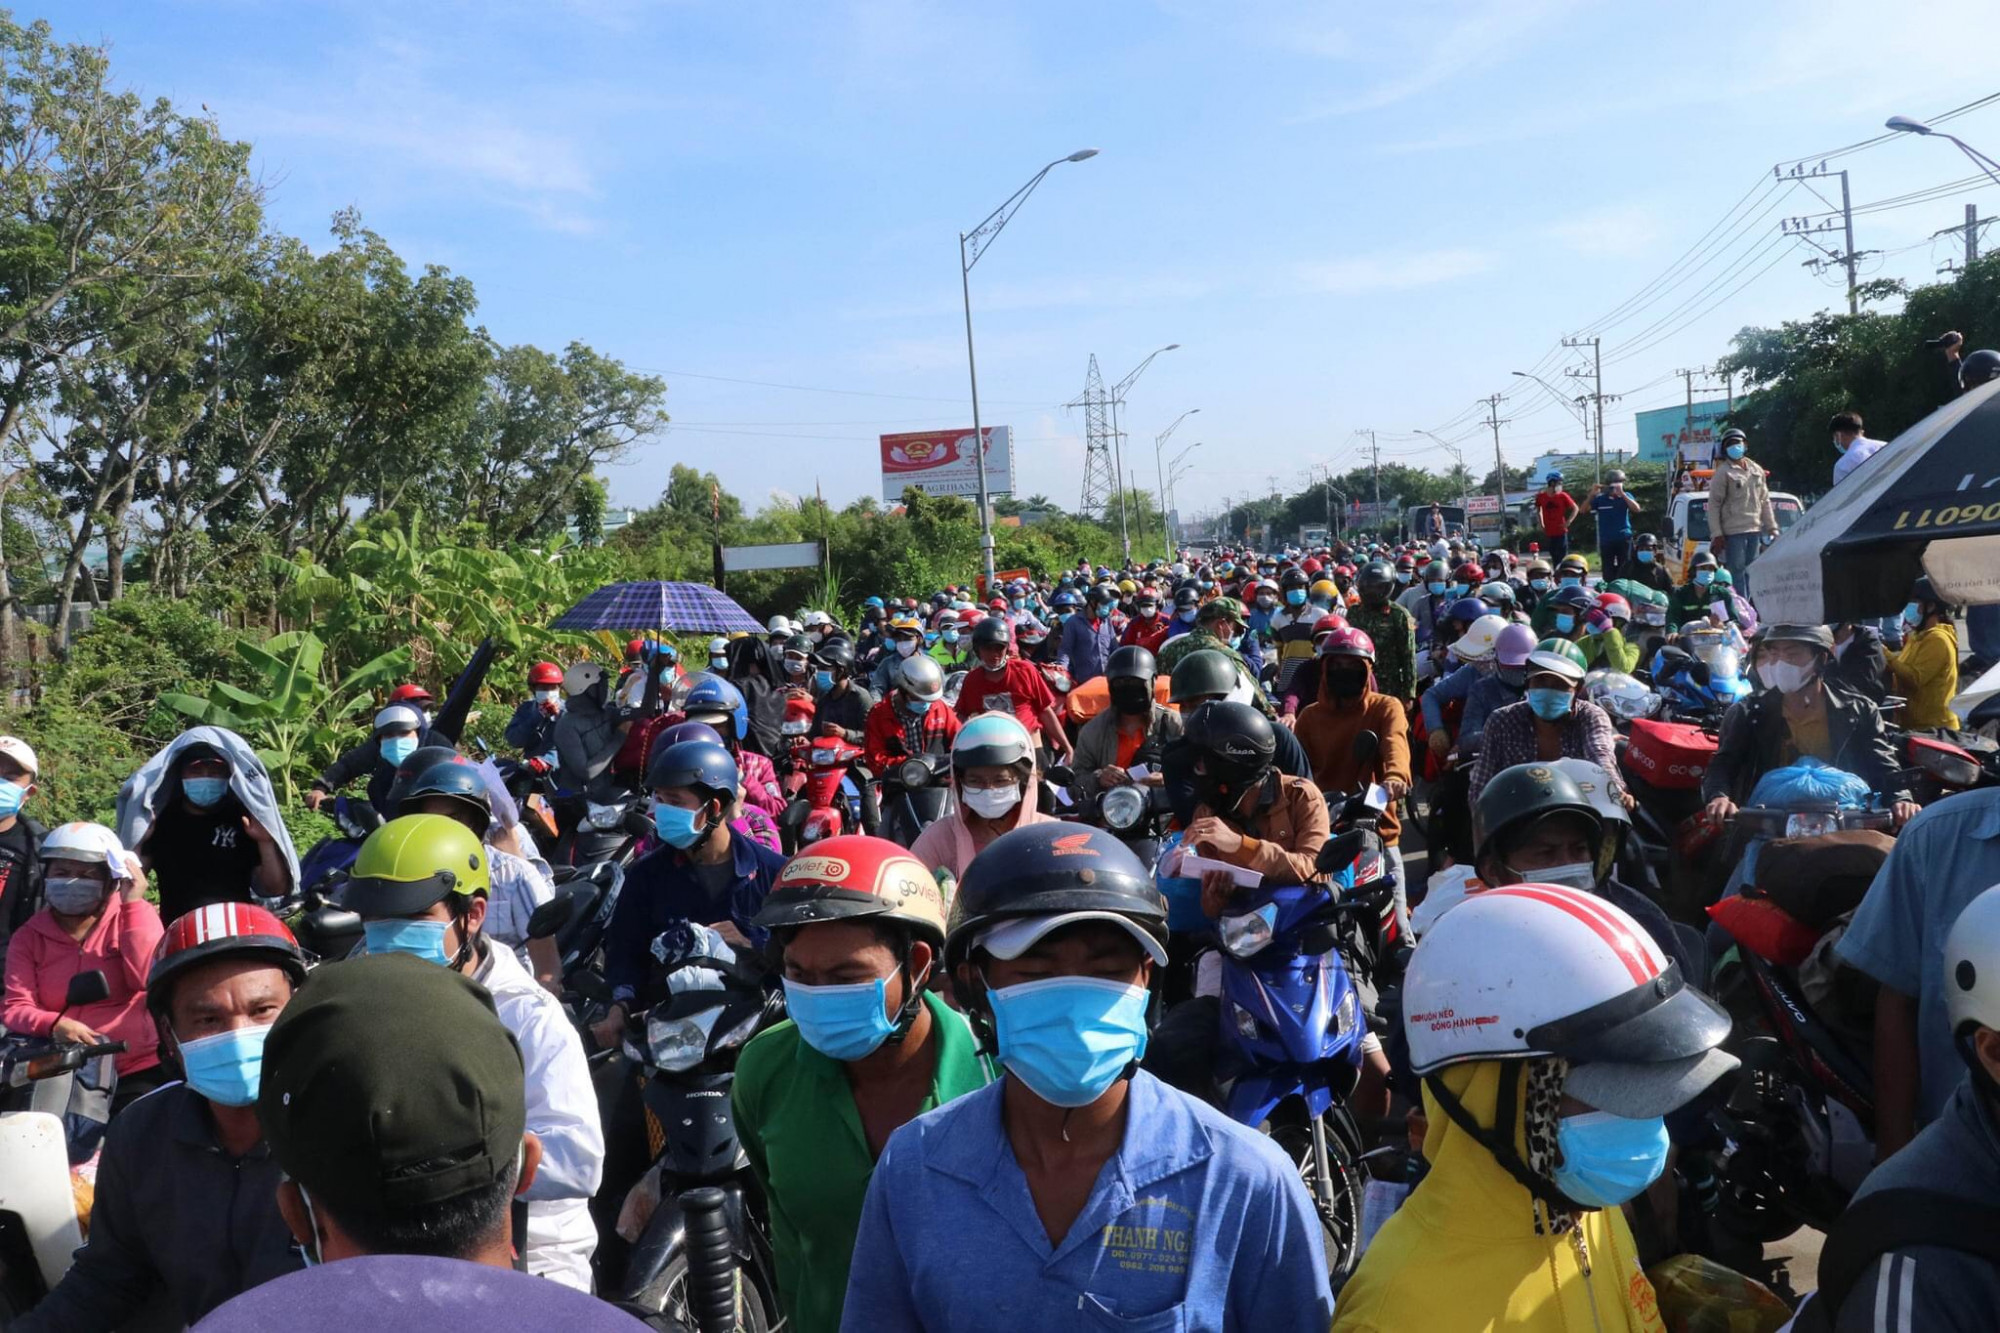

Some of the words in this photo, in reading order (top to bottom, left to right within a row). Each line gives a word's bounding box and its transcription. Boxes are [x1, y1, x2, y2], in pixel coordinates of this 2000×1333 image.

[686, 1091, 723, 1099] HONDA
[1103, 1226, 1158, 1250] THANH
[1163, 1229, 1188, 1252] NG
